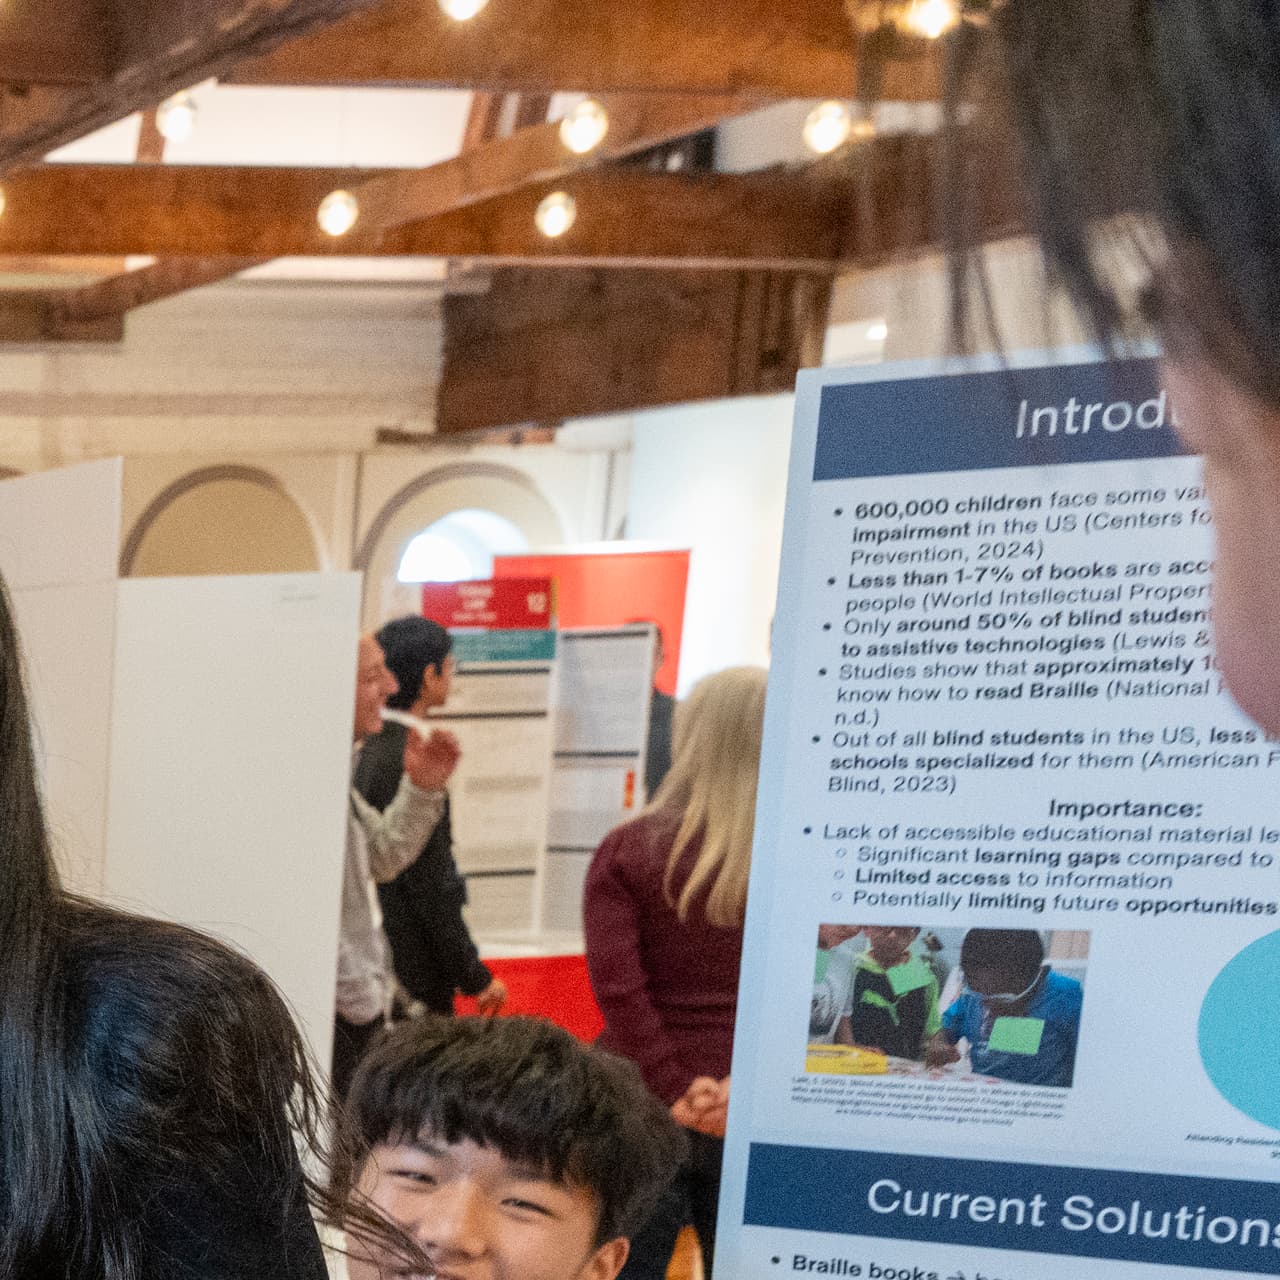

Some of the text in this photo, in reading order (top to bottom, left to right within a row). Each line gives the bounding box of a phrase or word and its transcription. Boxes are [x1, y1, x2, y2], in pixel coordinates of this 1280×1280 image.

[855, 499, 950, 520] 600,000
[955, 495, 1042, 514] children
[1051, 492, 1098, 508] face
[1106, 490, 1167, 505] some
[853, 522, 970, 546] impairment
[1004, 518, 1038, 534] the
[1045, 515, 1078, 533] US
[1084, 512, 1182, 533] (Centers
[851, 541, 1044, 566] Prevention, 2024)
[848, 574, 897, 589] Less
[903, 571, 949, 586] than
[957, 566, 1014, 584] 1-7%
[1049, 562, 1118, 581] books
[1125, 564, 1161, 576] are
[846, 595, 916, 616] people
[922, 591, 993, 611] (World
[1000, 585, 1123, 605] Intellectual
[844, 619, 891, 637] Only
[897, 615, 971, 633] around
[978, 612, 1033, 630] 50%
[1068, 609, 1123, 627] blind
[866, 633, 1188, 656] assistive technologies (Lewis
[840, 664, 917, 680] Studies
[923, 663, 979, 678] show
[986, 661, 1027, 676] that
[1033, 656, 1195, 678] approximately
[837, 688, 892, 703] know
[898, 686, 942, 701] how
[975, 683, 1024, 700] read
[1030, 682, 1099, 699] Braille
[1107, 679, 1211, 697] (National
[835, 709, 880, 728] n.d.)
[833, 727, 1257, 748] Out all blind students the US, less
[831, 752, 1259, 773] schools specialized for them (American
[828, 776, 957, 796] Blind, 2023)
[1049, 799, 1203, 821] Importance:
[824, 824, 1253, 843] Lack accessible educational material
[858, 846, 1243, 870] Significant learning gaps compared
[856, 868, 1173, 889] Limited access information
[853, 890, 1278, 916] Potentially limiting future opportunities
[867, 1179, 1047, 1228] Current
[792, 1255, 862, 1278] Braille
